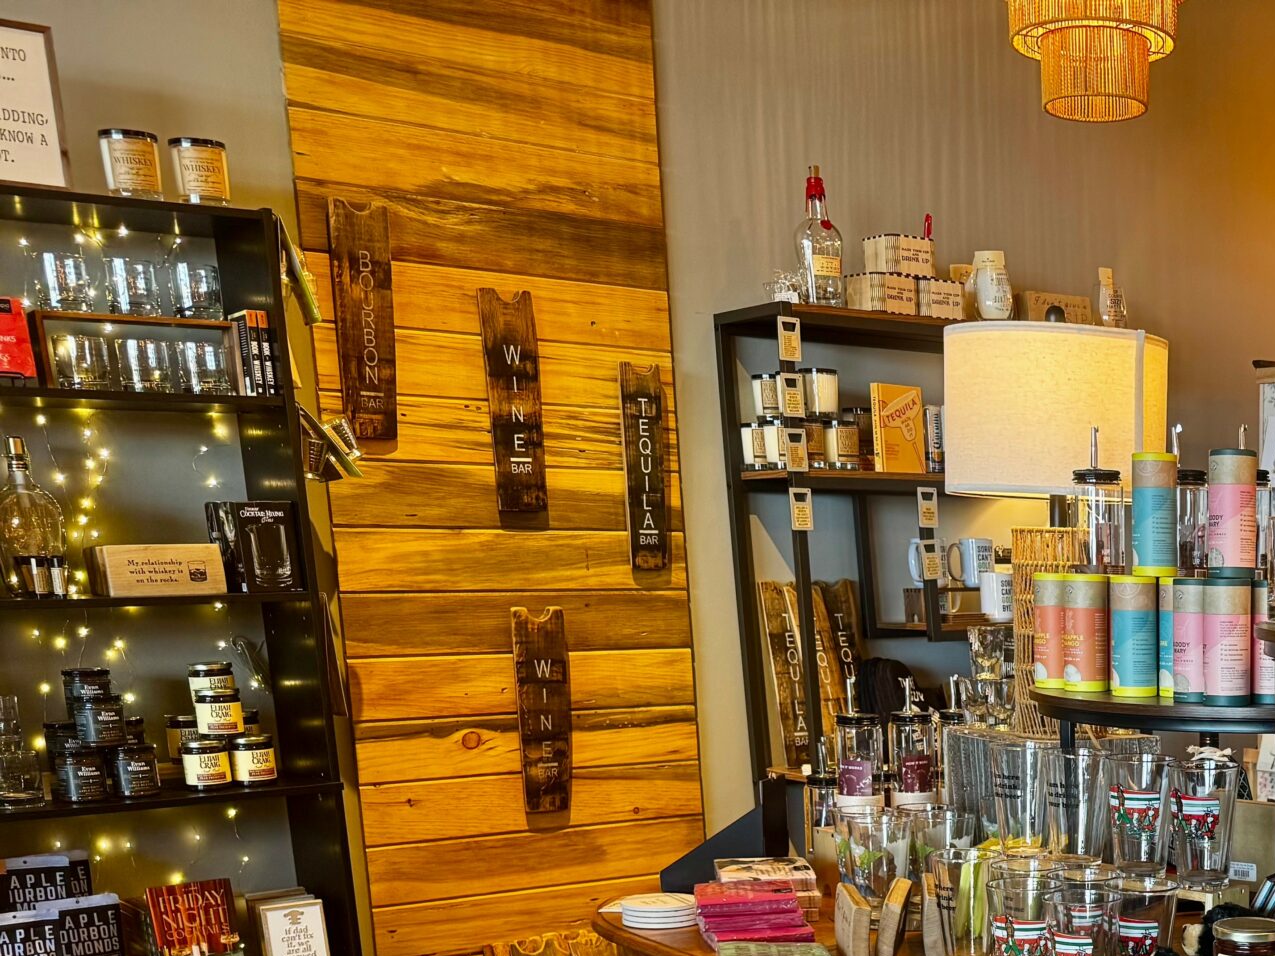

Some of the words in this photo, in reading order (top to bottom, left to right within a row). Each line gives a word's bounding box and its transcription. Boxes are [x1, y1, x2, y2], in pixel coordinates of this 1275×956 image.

[112, 154, 154, 168] WHISKEY
[358, 250, 379, 385] BOURBON
[361, 397, 384, 409] BAR
[503, 345, 527, 452] WINE
[886, 398, 917, 424] TEQUILA
[511, 462, 533, 475] BAR
[638, 397, 655, 530] TEQUILA
[639, 534, 660, 546] BAR
[210, 704, 231, 712] ELIJAH
[210, 710, 233, 720] CRAIG
[534, 658, 552, 758] WINE
[538, 766, 558, 779] BAR
[159, 889, 225, 912] FRIDAY
[162, 906, 227, 931] NIGHT
